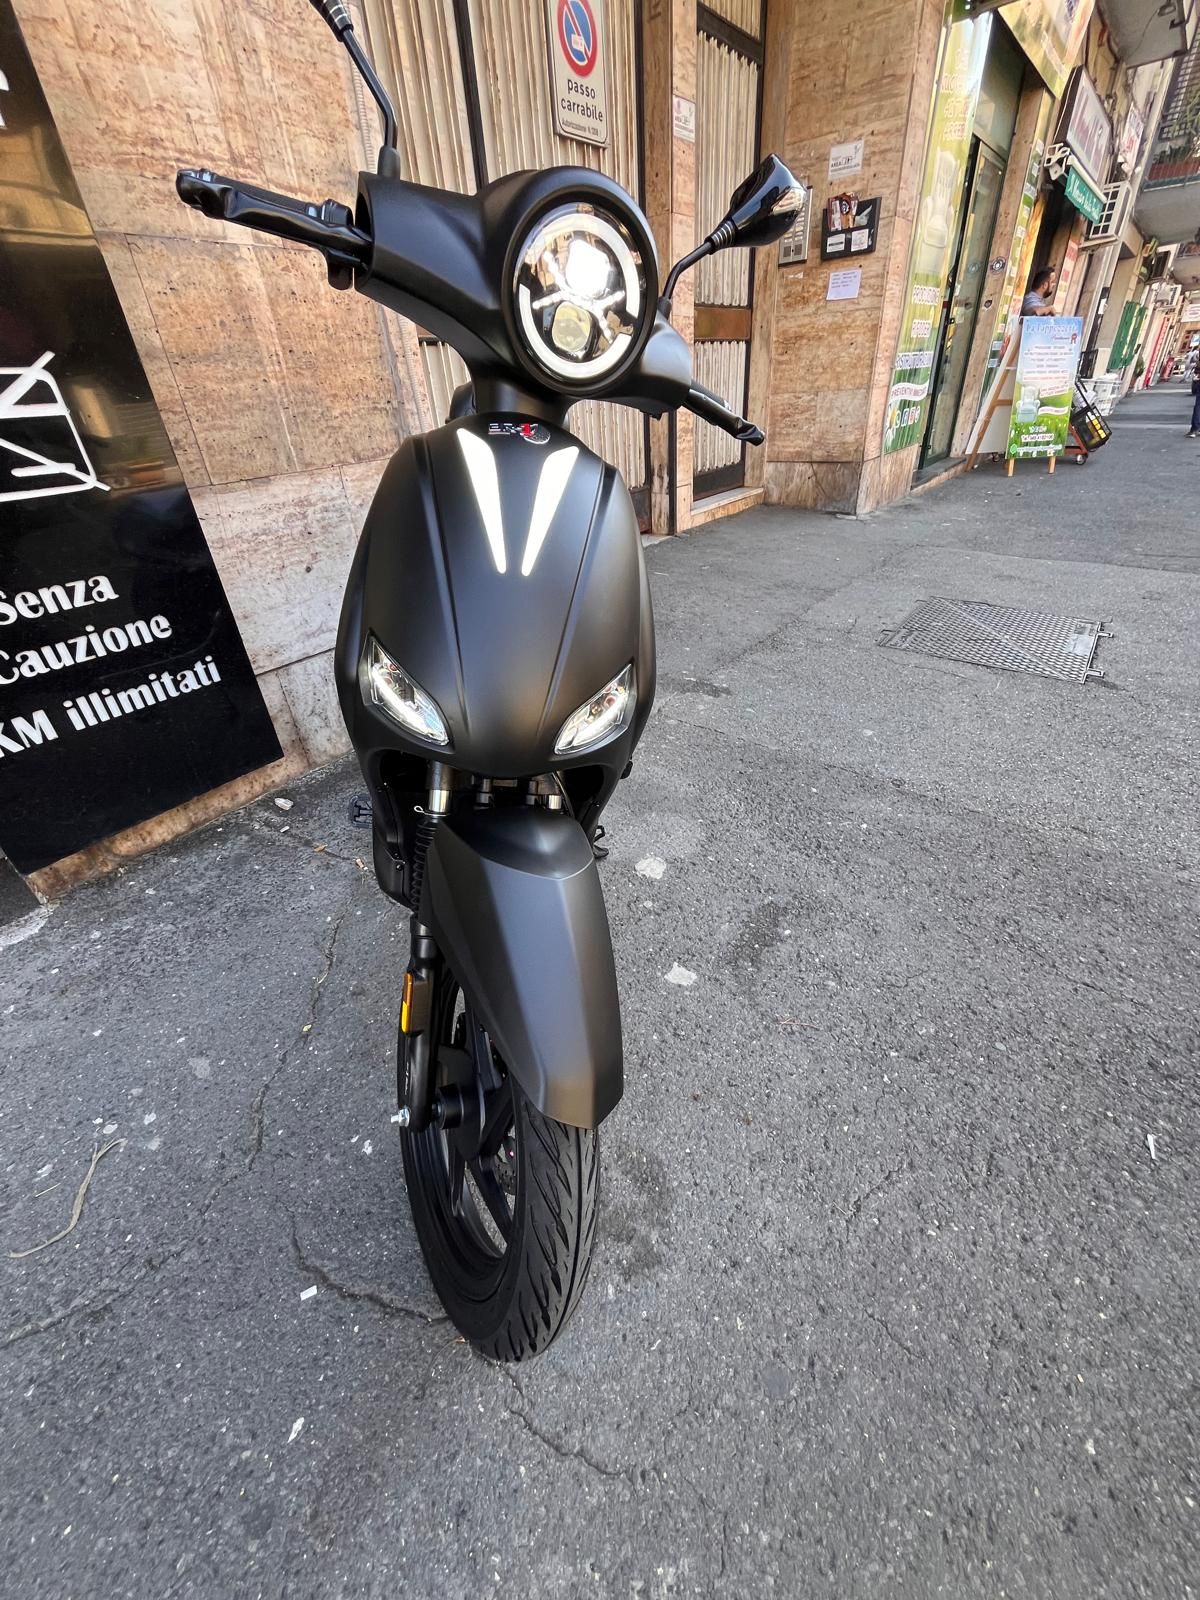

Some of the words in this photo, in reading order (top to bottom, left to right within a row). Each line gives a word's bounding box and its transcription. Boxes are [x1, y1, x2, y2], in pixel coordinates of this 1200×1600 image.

[567, 79, 596, 99] passo
[561, 97, 604, 122] carrabile
[62, 655, 221, 731] illimitati
